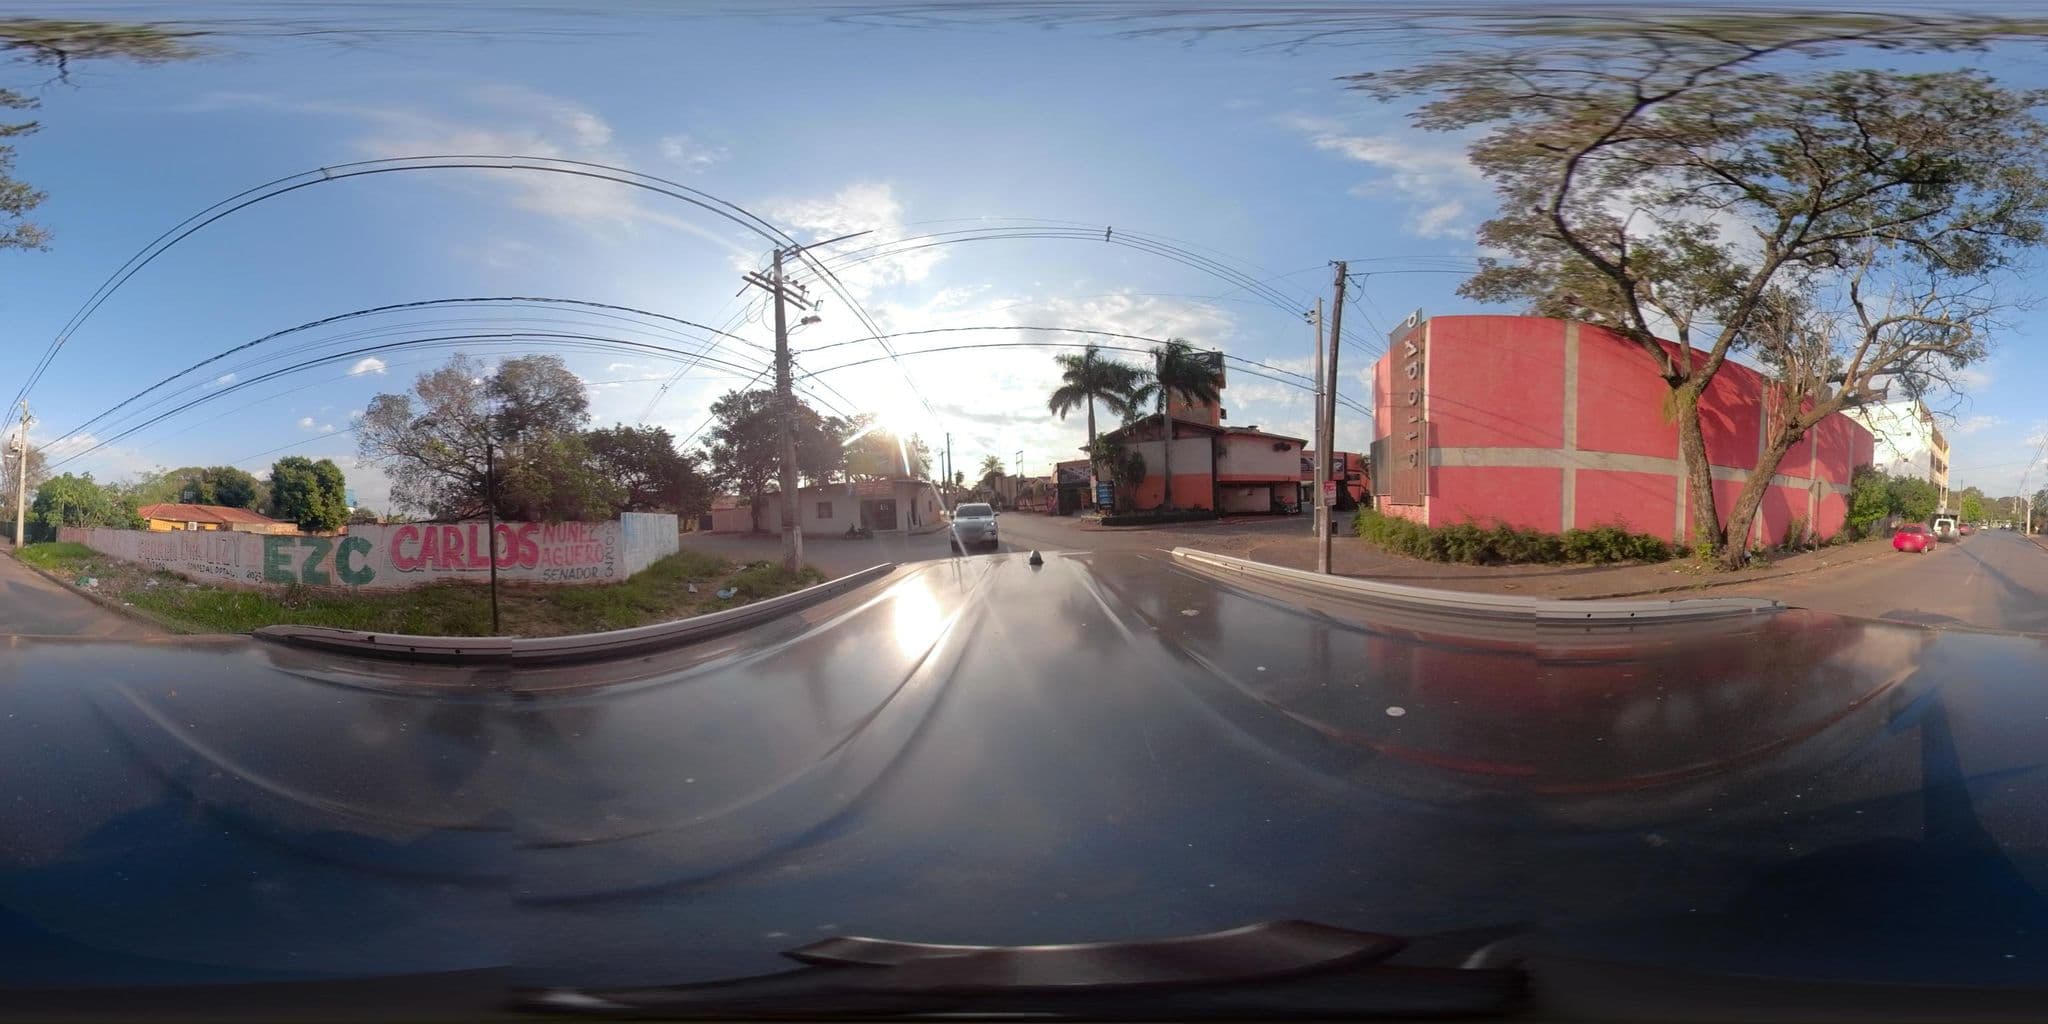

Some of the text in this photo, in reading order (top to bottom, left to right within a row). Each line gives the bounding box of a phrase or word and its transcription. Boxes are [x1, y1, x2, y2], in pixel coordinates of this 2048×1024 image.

[263, 536, 376, 585] EZC
[390, 522, 540, 572] CARLOS
[543, 567, 599, 581] SENADOR
